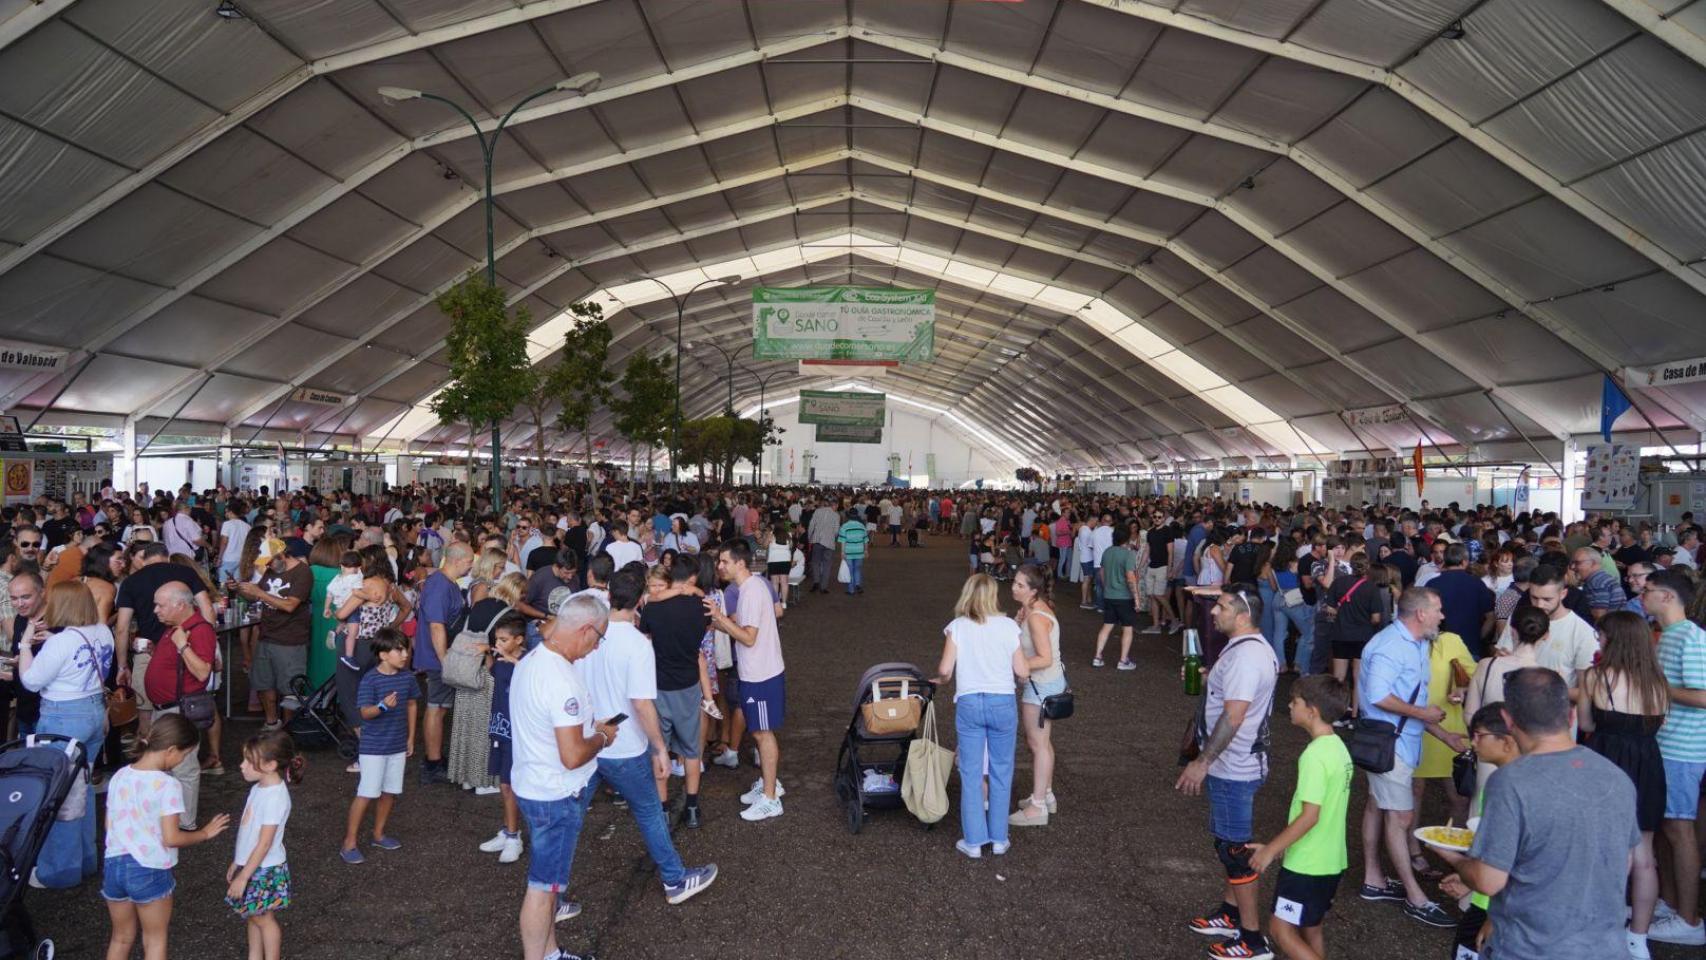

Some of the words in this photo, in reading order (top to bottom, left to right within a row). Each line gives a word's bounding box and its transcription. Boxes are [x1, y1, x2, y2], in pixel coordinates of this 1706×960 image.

[795, 318, 839, 333] SANO
[1, 351, 15, 363] de
[17, 351, 58, 368] Valencia
[1664, 368, 1684, 380] Casa
[1686, 365, 1697, 378] de
